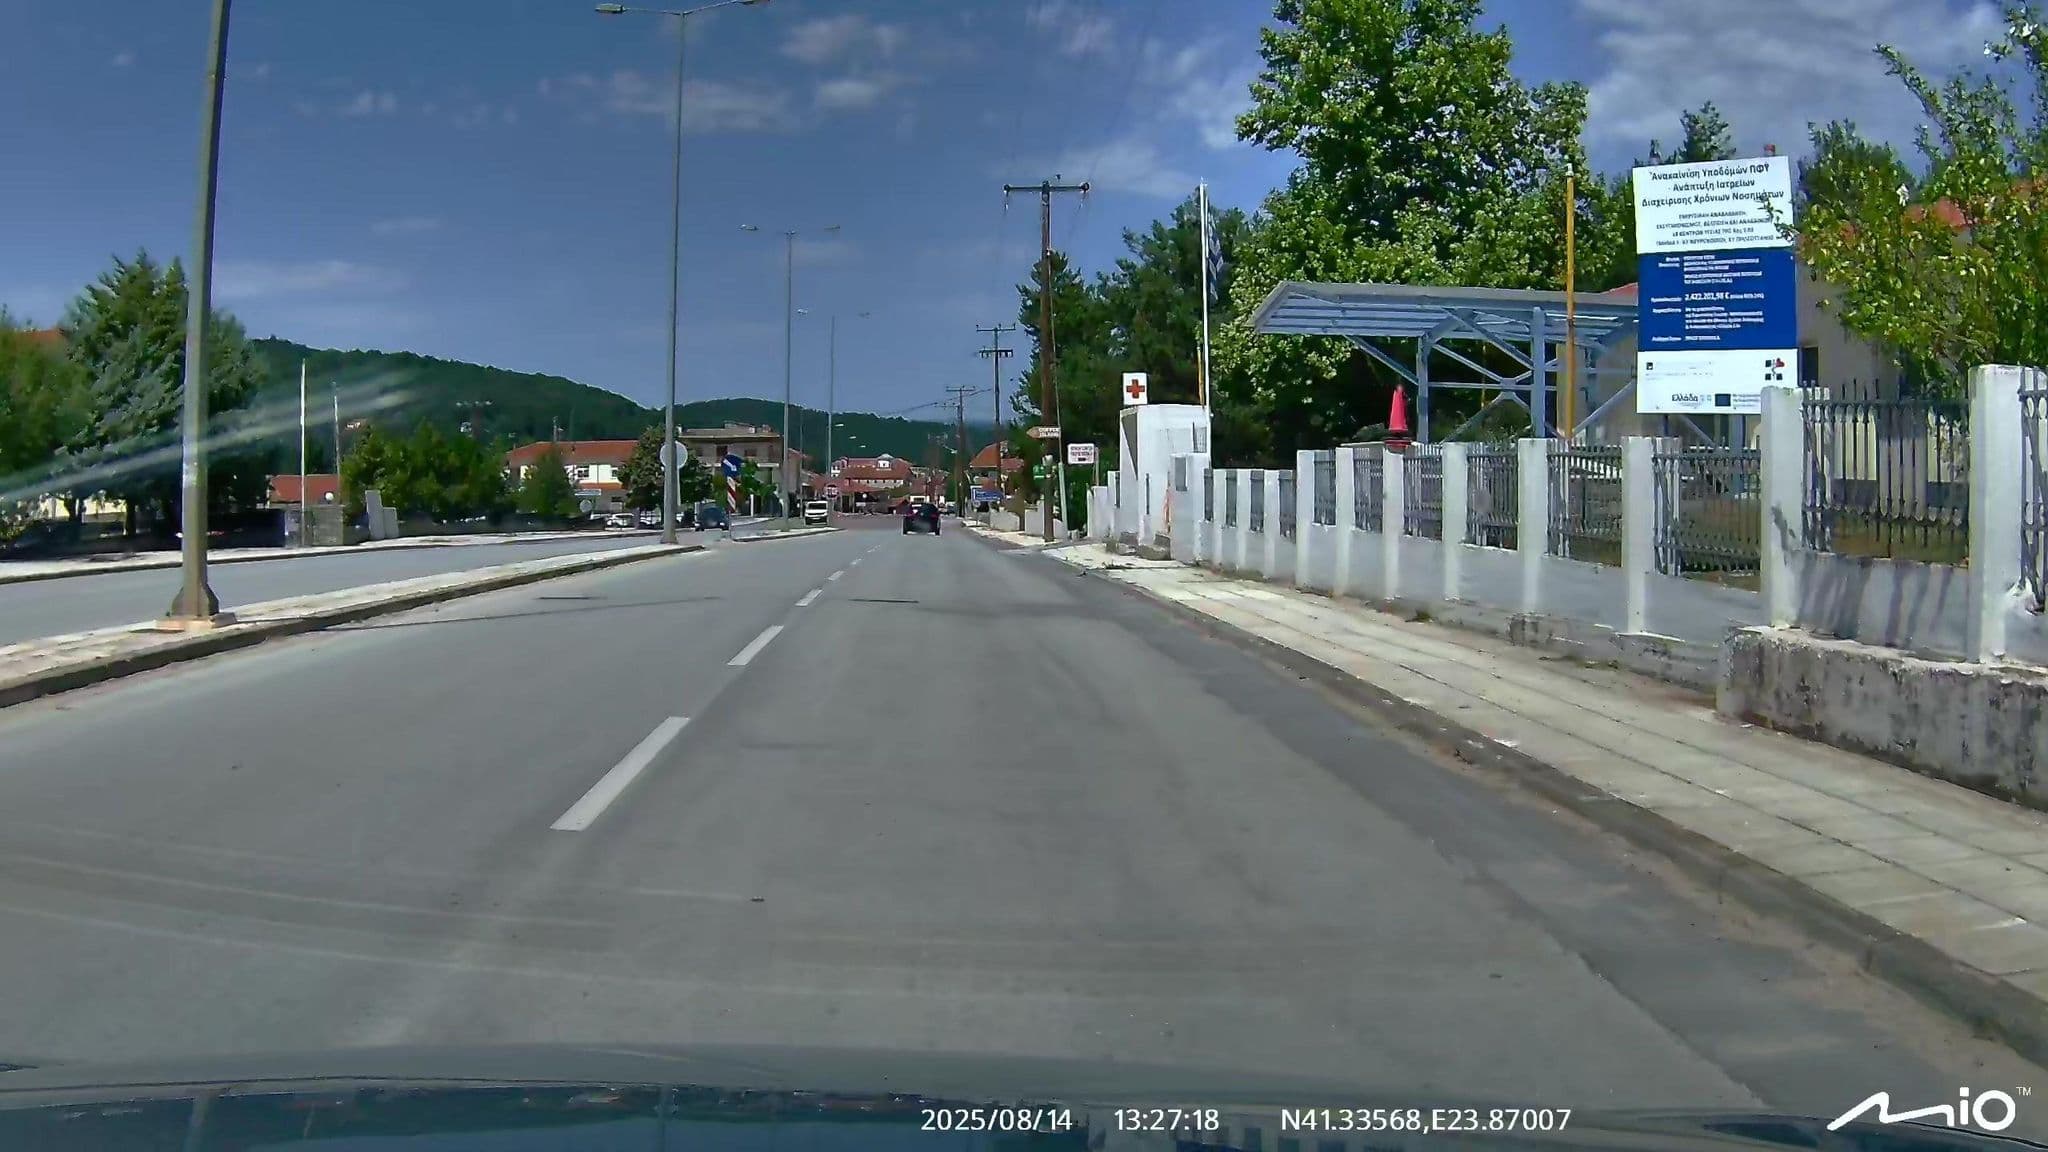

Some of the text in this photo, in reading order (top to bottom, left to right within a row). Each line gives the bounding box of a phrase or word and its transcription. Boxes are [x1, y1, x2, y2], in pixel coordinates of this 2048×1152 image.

[1673, 179, 1755, 191] Ανάπτυξη Ιατρείων
[1642, 195, 1692, 208] Διαχείρισης
[1694, 193, 1730, 204] Χρόνιων
[1671, 393, 1699, 402] Ελλάδα
